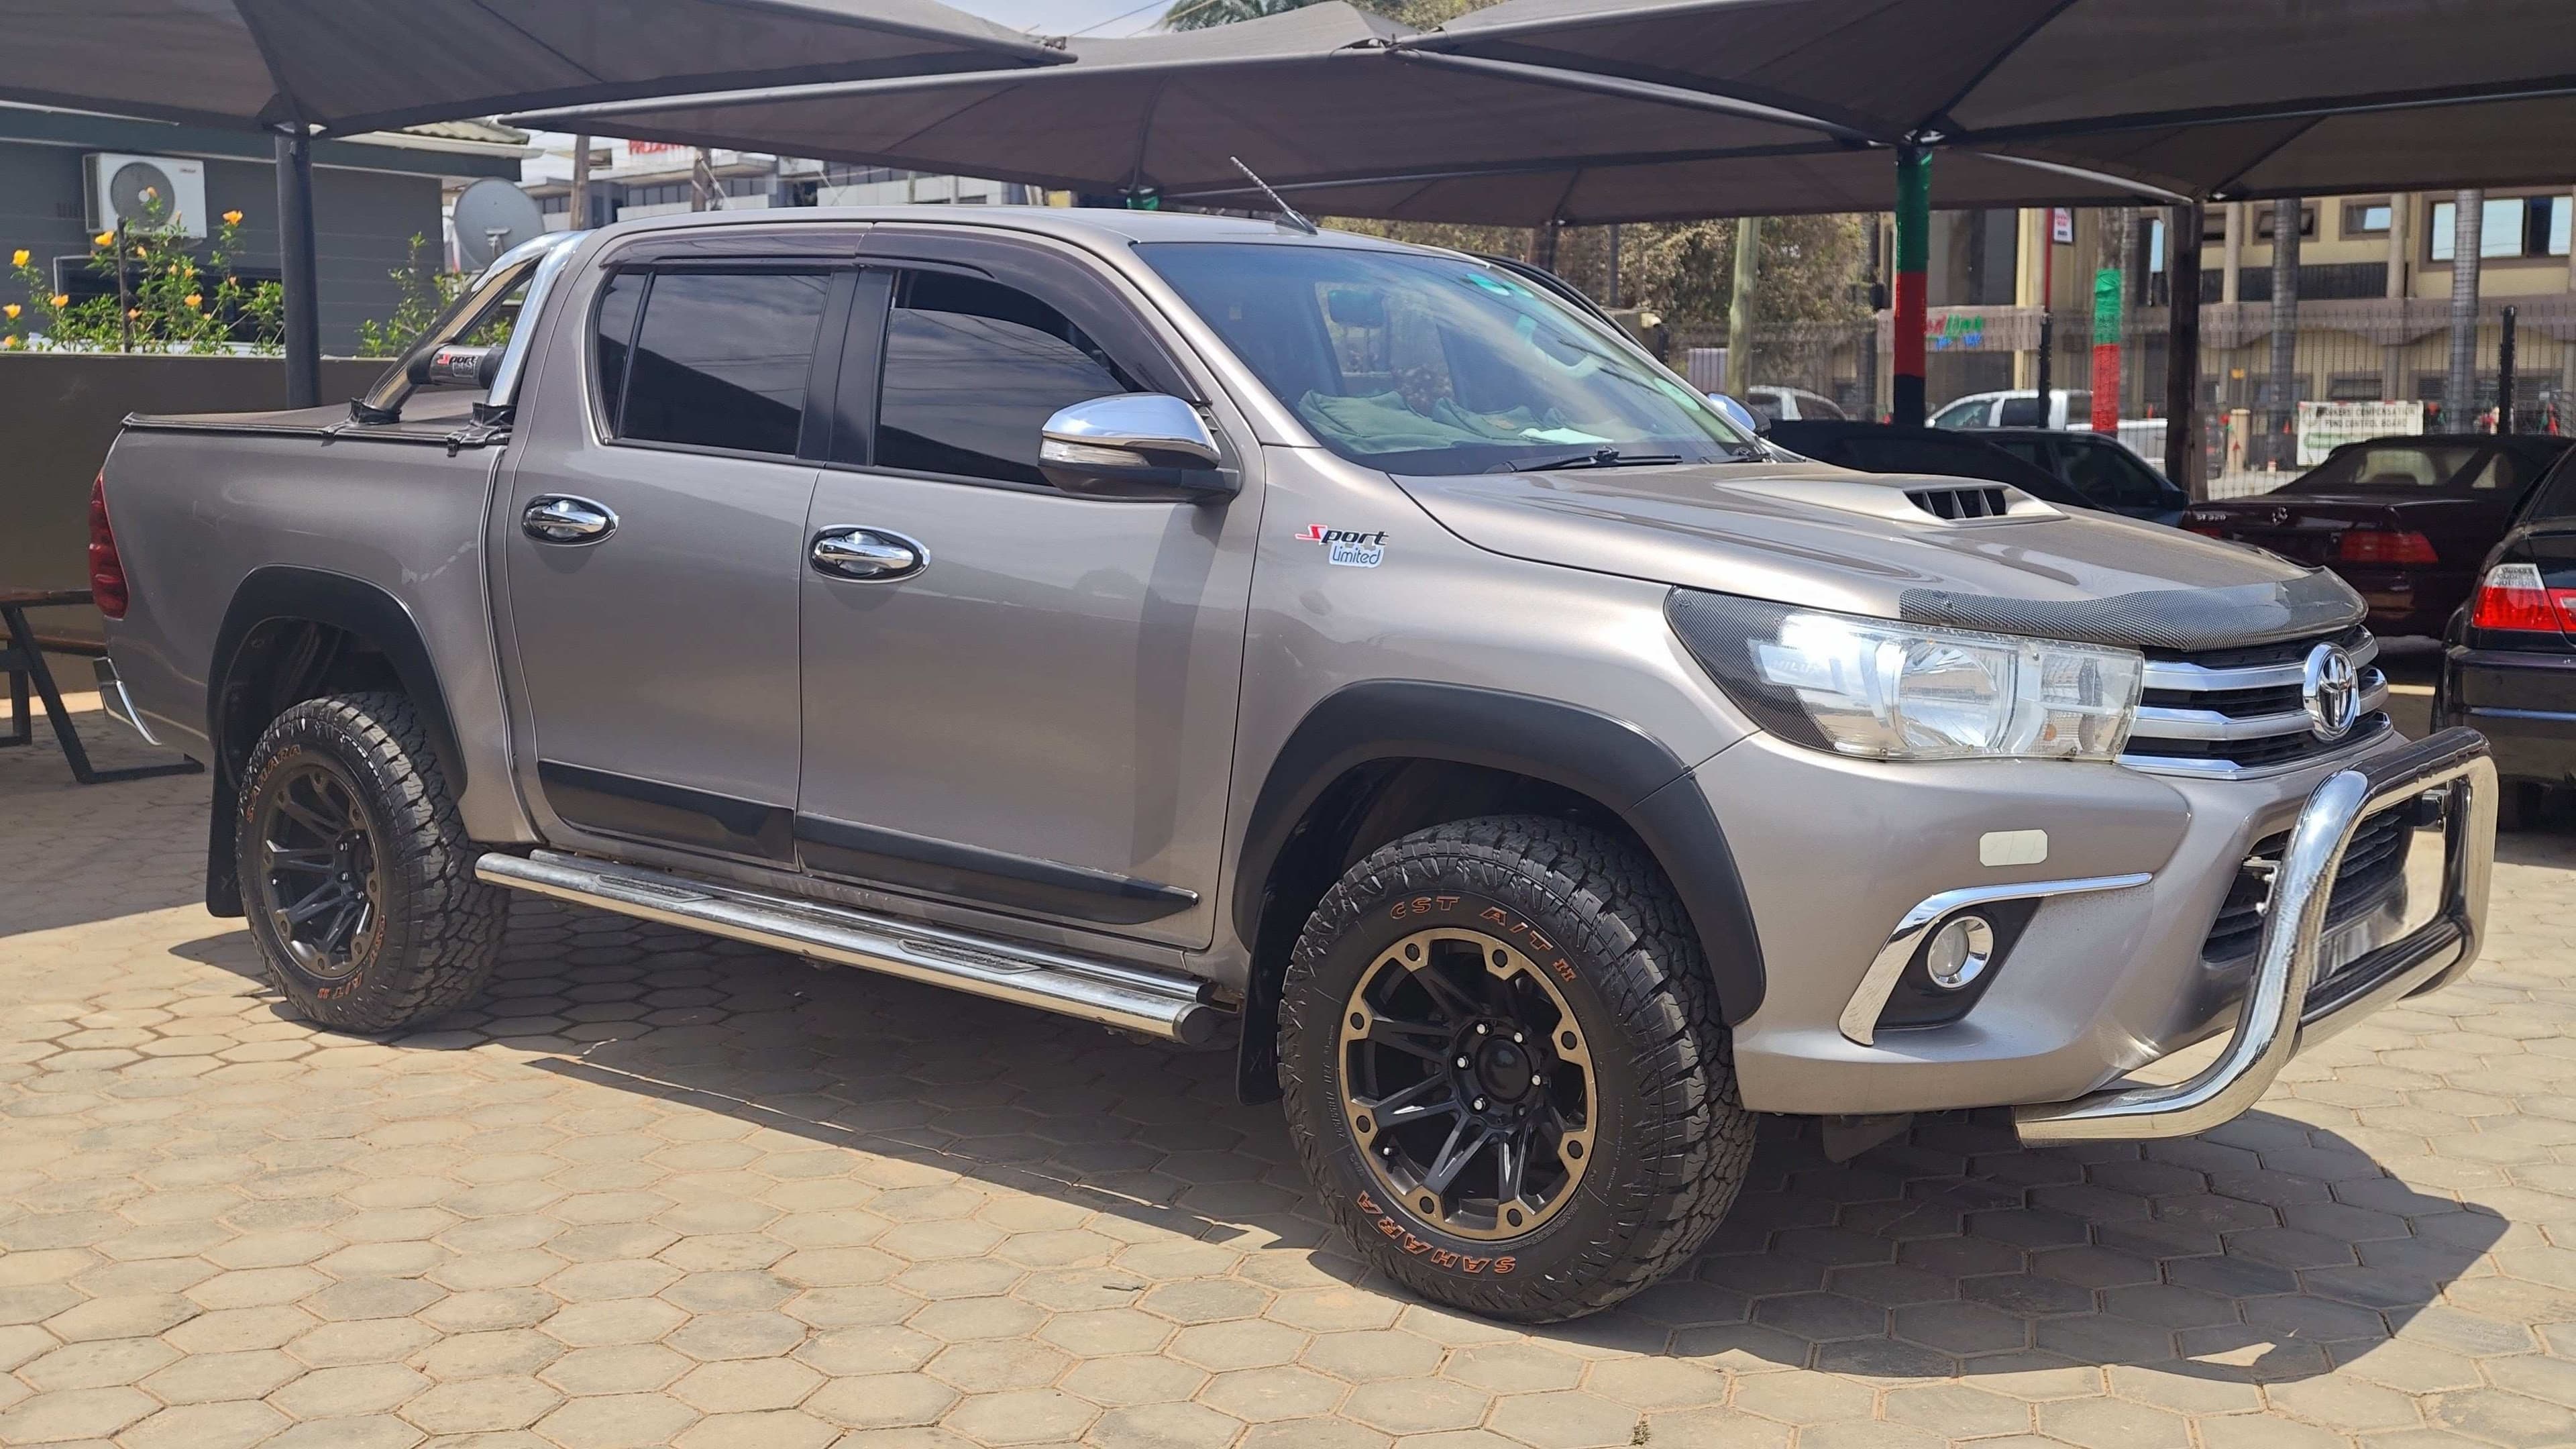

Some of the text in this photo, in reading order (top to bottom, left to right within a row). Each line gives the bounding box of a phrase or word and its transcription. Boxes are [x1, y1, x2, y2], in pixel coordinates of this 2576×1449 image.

[2345, 419, 2378, 428] CONTROL
[2381, 419, 2407, 427] BOARD
[1295, 525, 1389, 545] Sport
[1390, 896, 1460, 920] CST
[1479, 906, 1554, 951] A/T
[1356, 1190, 1517, 1274] SAHARA
